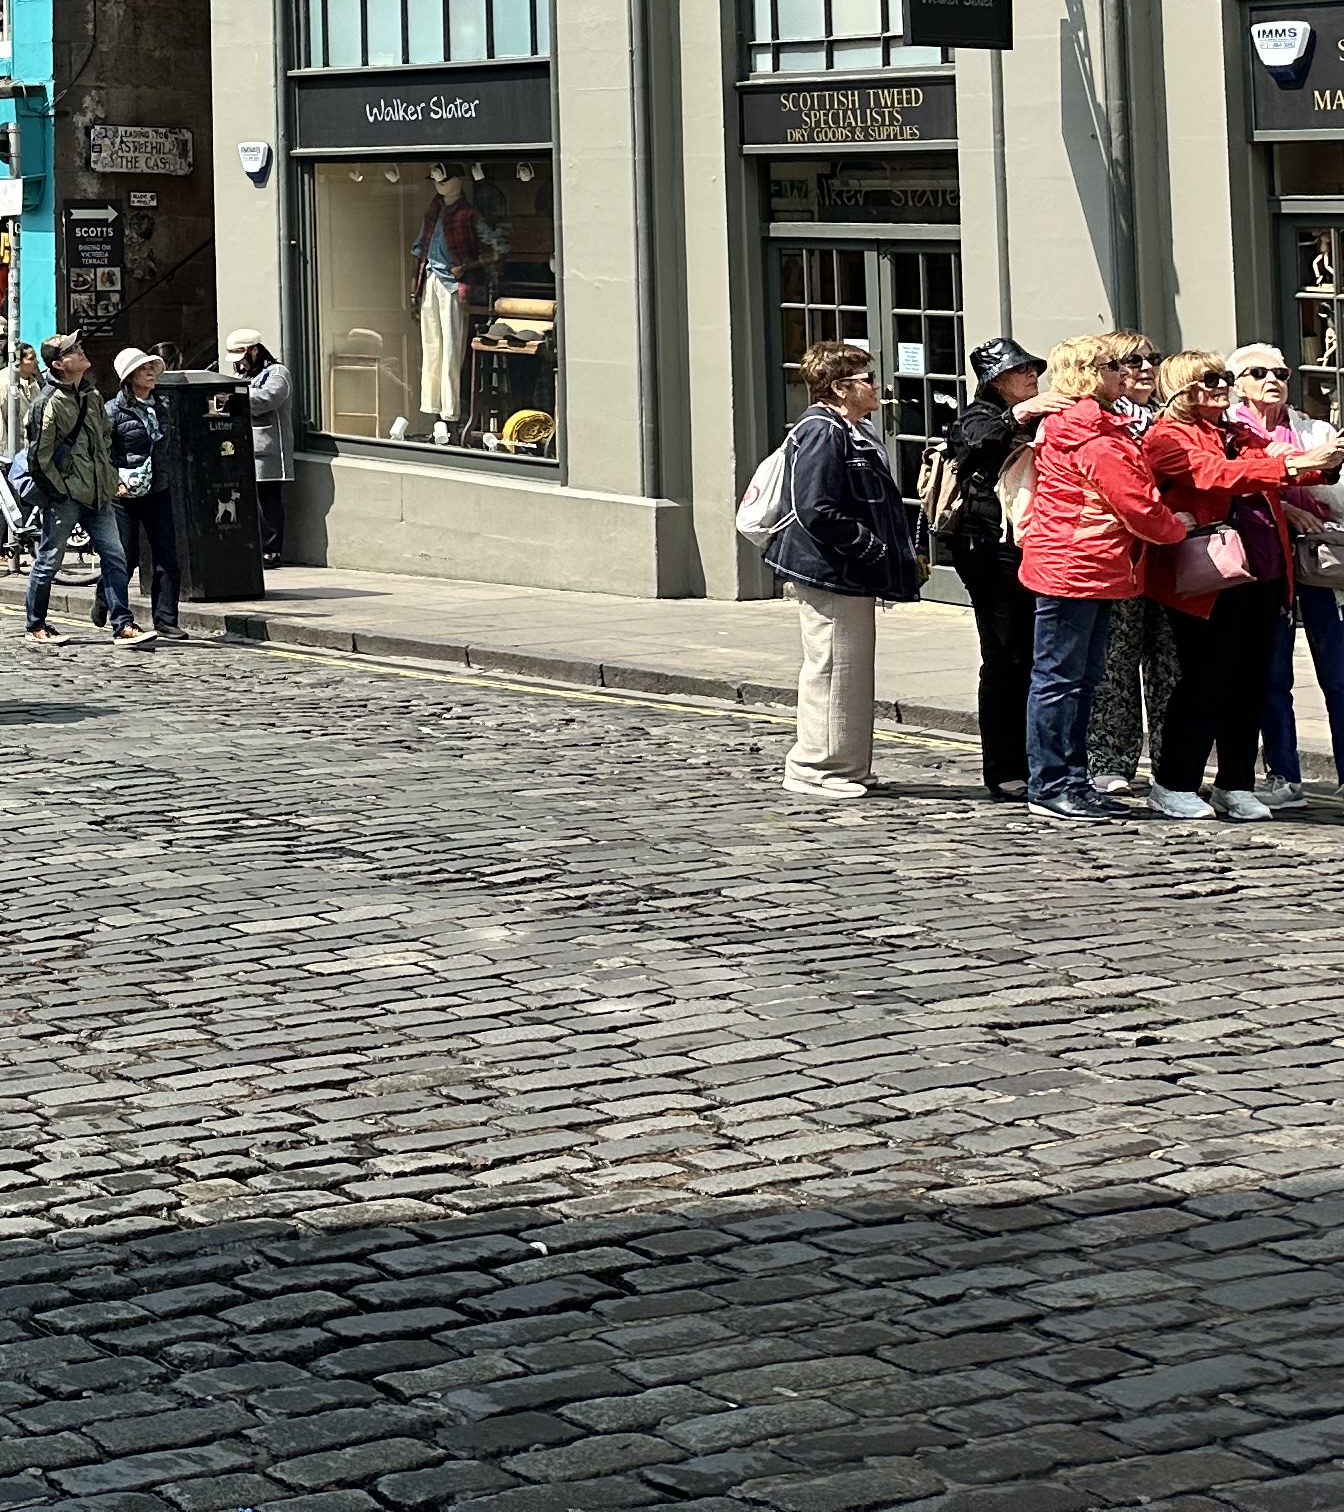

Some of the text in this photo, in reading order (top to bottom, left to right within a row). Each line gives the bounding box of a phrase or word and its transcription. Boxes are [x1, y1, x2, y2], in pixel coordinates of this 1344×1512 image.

[1257, 27, 1298, 39] IMMS
[780, 88, 923, 112] SCOTTISH TWEED
[366, 96, 479, 123] Walker Slater
[801, 108, 903, 129] SPECIALISTS
[787, 125, 920, 143] DRY GOODS & SUPPLIES
[119, 156, 140, 169] THE
[75, 227, 114, 238] SCOTTS
[209, 421, 234, 431] Litter
